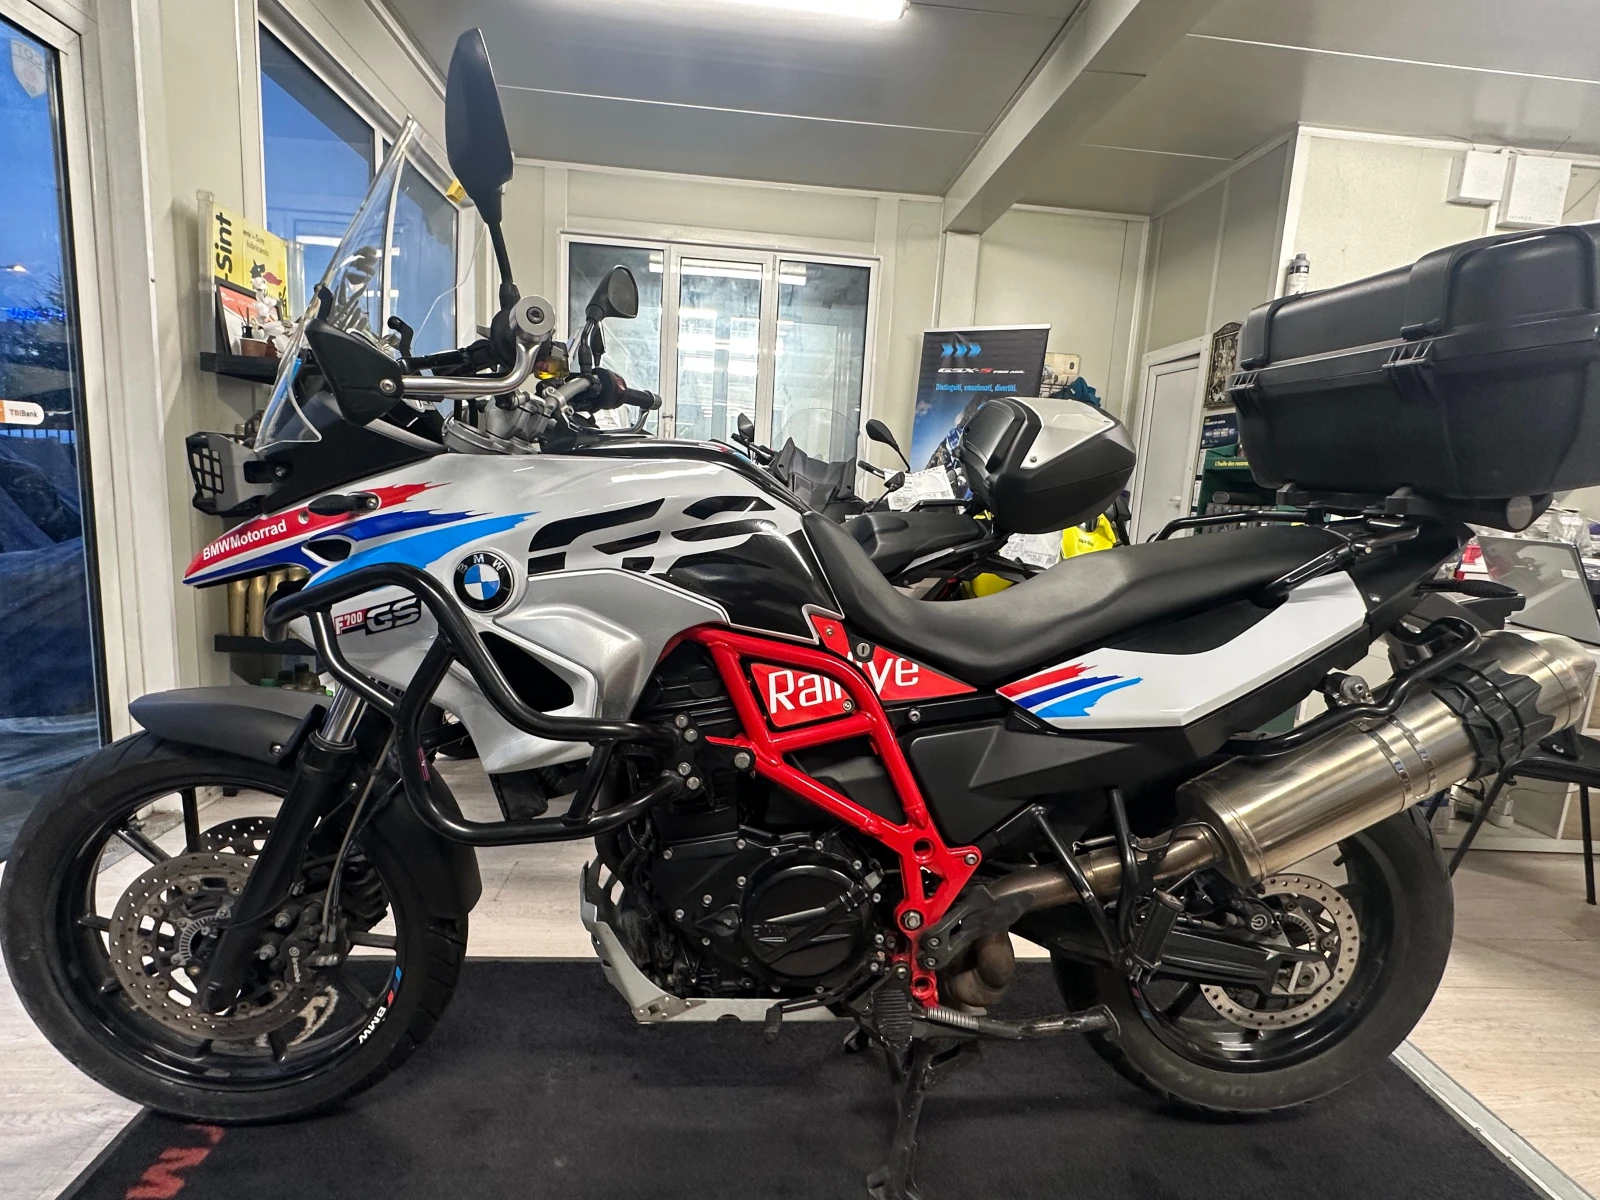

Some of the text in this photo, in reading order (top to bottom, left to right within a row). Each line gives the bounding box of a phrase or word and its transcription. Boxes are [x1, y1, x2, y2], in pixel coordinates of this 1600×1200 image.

[215, 212, 232, 280] -Sint
[935, 383, 1018, 393] Distinguiti, emozionati, divertiti.
[456, 553, 504, 574] BMW
[366, 597, 420, 632] GS
[291, 957, 302, 983] brembo
[358, 1005, 387, 1045] BMW
